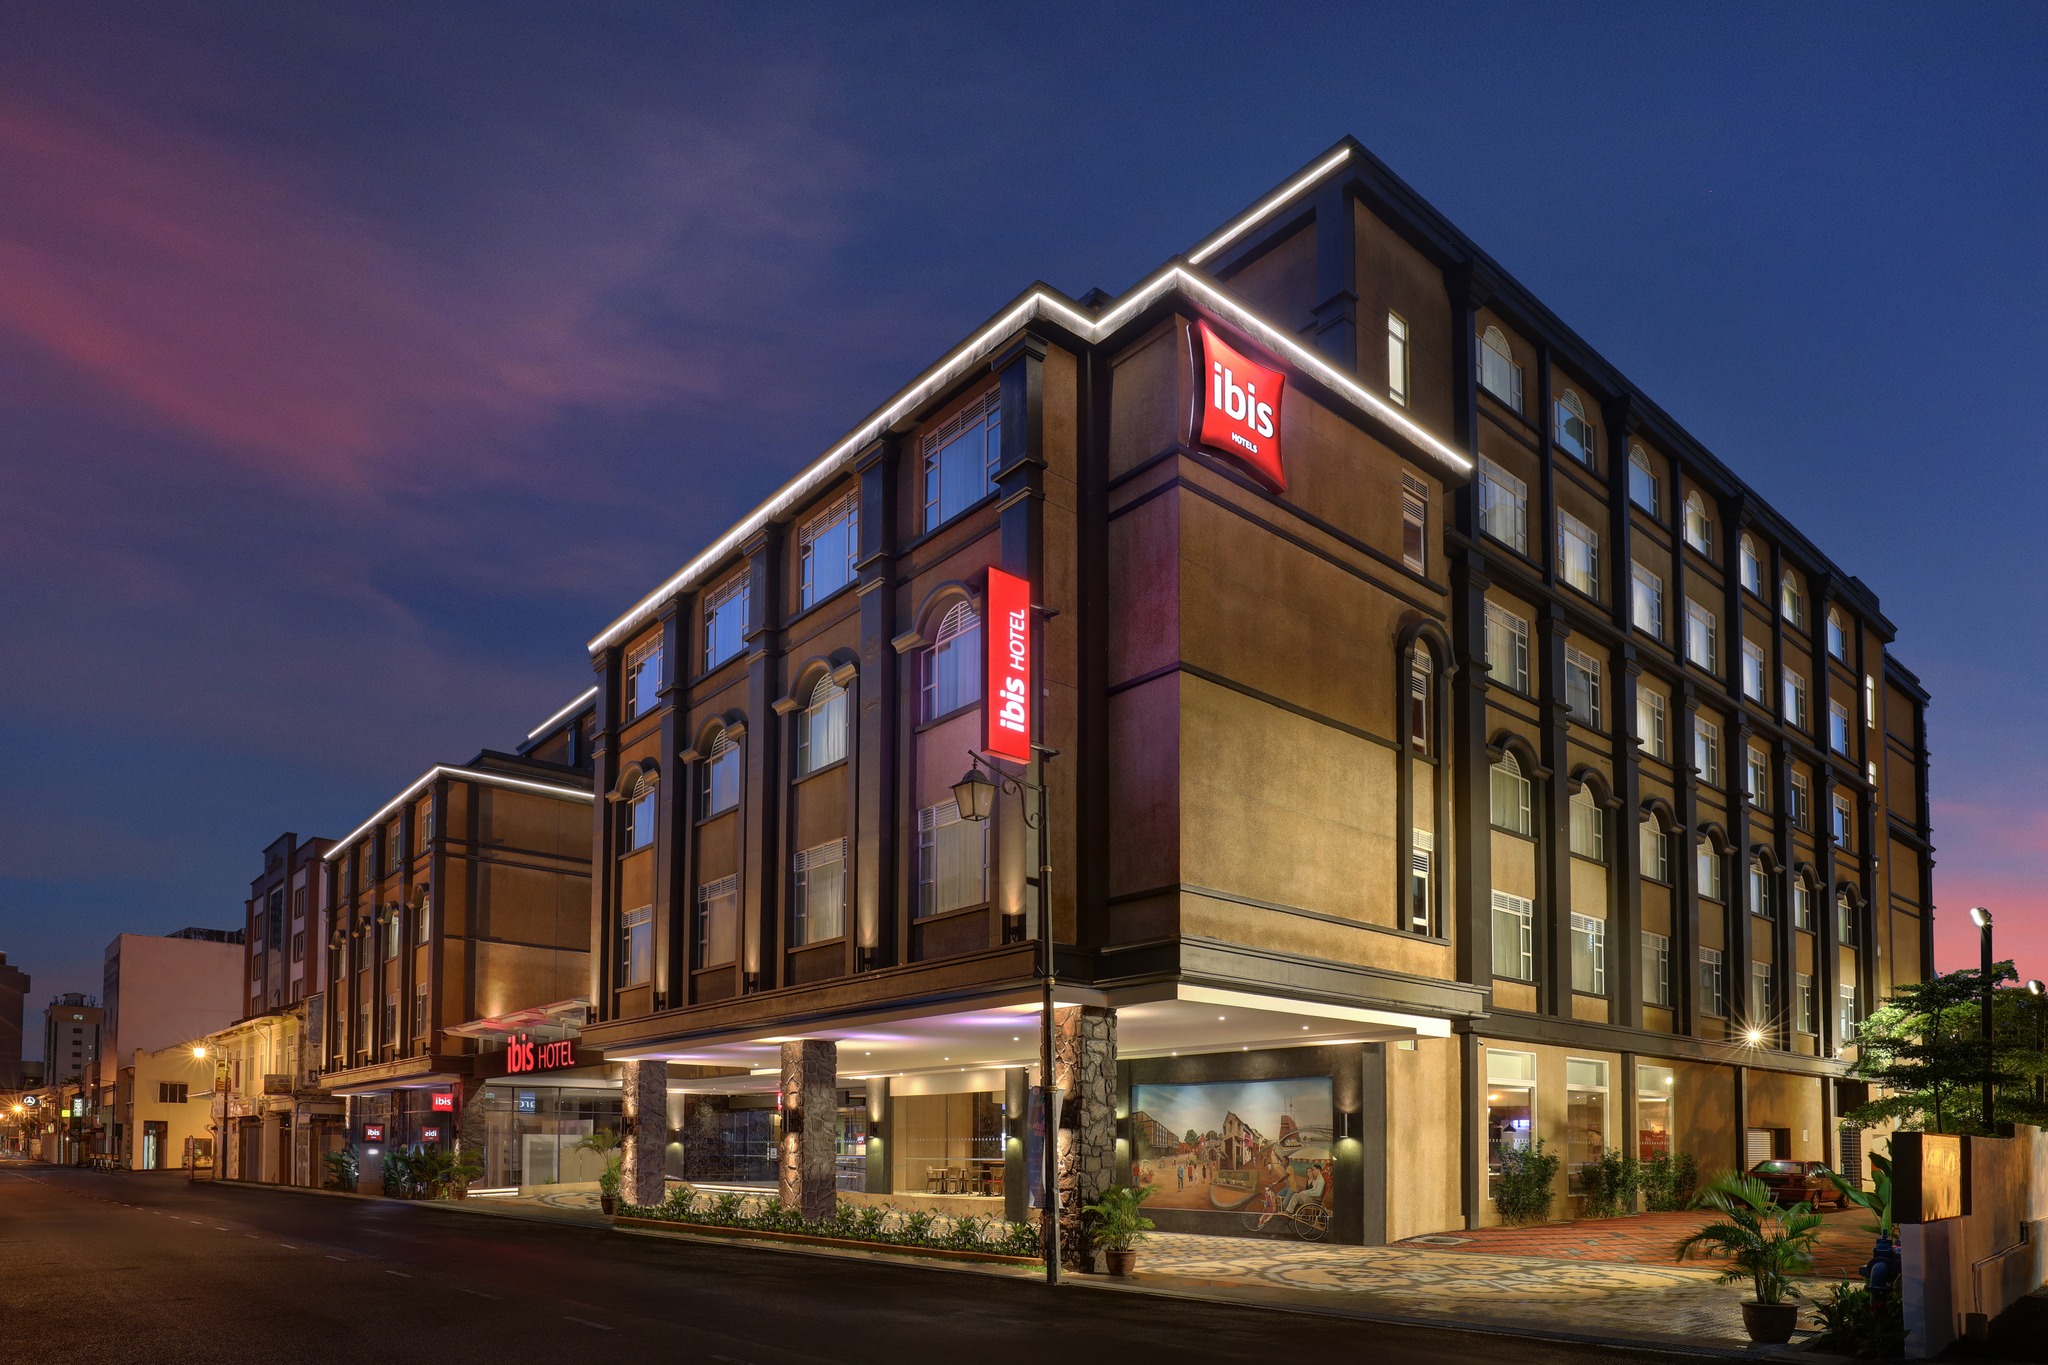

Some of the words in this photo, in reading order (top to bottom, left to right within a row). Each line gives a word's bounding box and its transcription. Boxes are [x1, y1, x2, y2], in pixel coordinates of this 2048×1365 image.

[1213, 361, 1274, 438] ibis
[1231, 432, 1258, 454] HOTELS
[1009, 608, 1025, 671] HOTEL
[999, 676, 1025, 733] ibis
[507, 1033, 534, 1073] ibis
[538, 1041, 575, 1069] HOTEL
[435, 1097, 452, 1106] ibis
[367, 1128, 380, 1136] ibis
